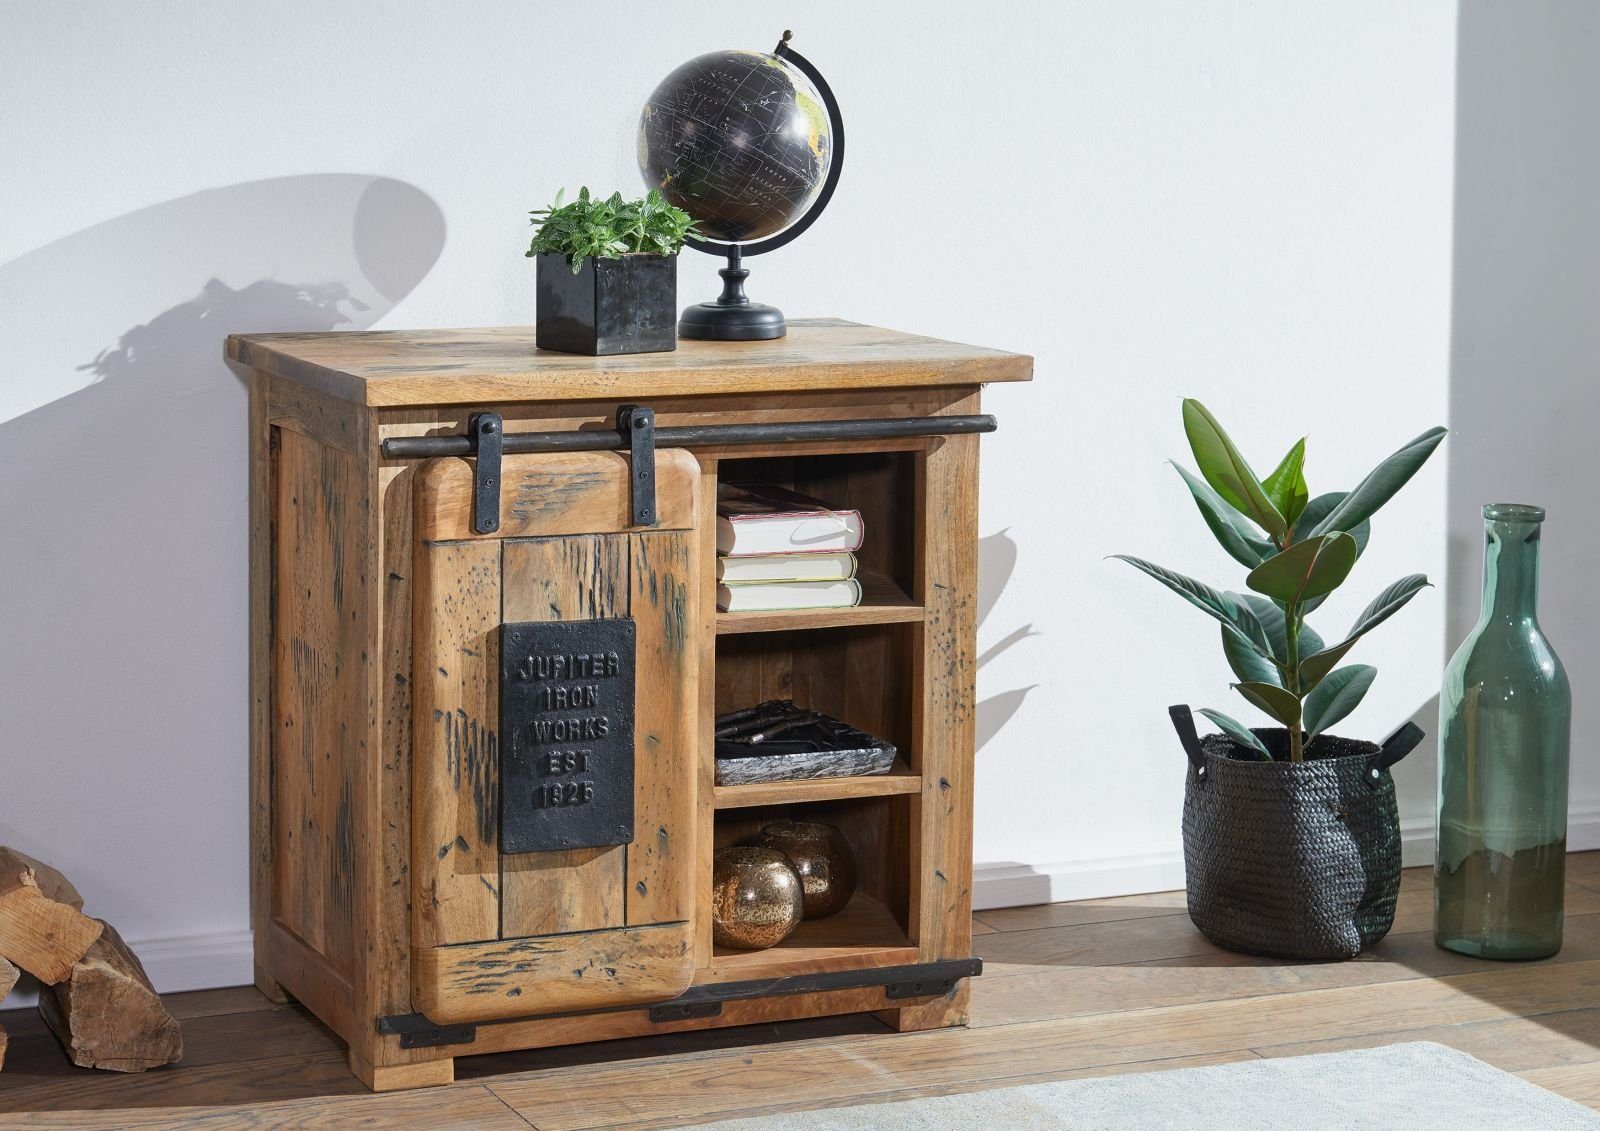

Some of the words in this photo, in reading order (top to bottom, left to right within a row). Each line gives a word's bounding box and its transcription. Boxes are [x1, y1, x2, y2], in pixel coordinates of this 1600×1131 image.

[518, 651, 620, 680] JUPITER
[543, 684, 599, 711] IRON
[530, 716, 609, 743] WORKS
[547, 749, 592, 773] EST
[541, 781, 594, 808] 1925
